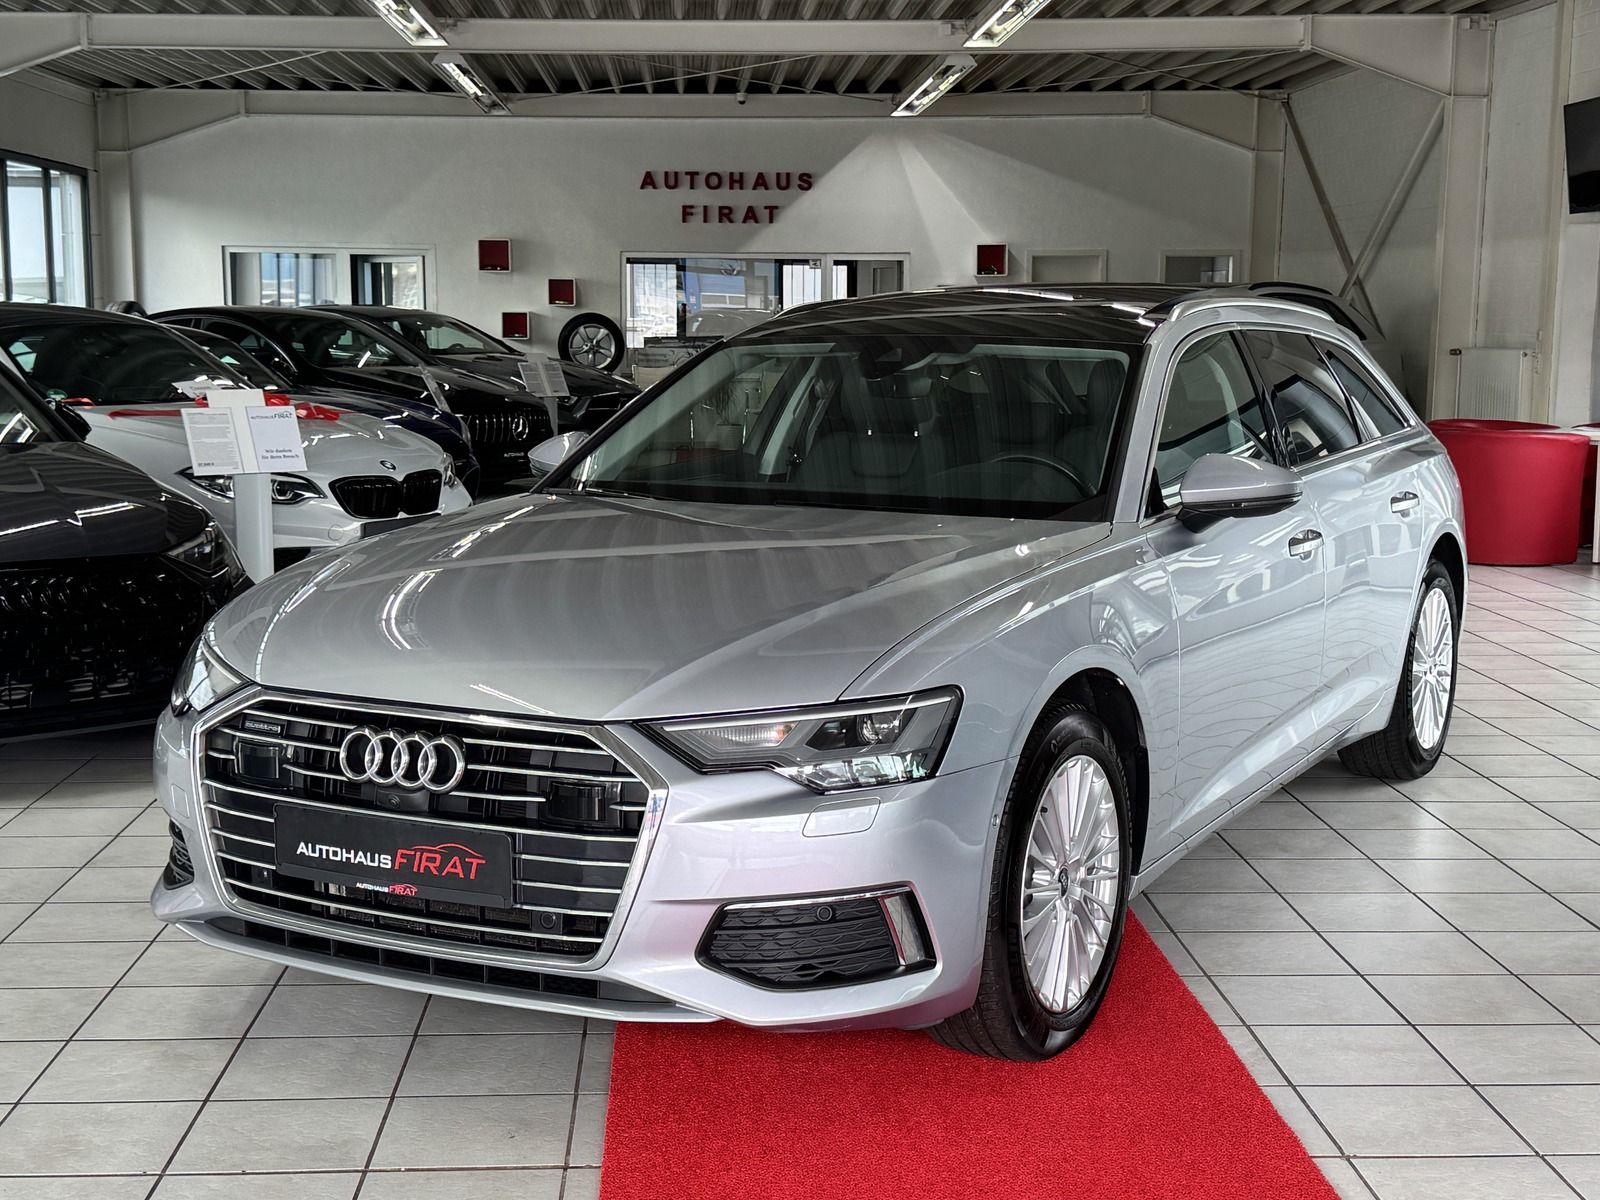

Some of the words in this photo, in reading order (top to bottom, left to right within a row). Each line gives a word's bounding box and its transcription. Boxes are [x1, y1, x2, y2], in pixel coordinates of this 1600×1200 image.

[640, 171, 813, 191] AUTOHAUS
[681, 205, 779, 224] FIRAT
[296, 841, 392, 869] AUTOHAUS
[394, 848, 487, 880] FIRAT
[356, 881, 389, 893] AUTOHAUS
[389, 884, 418, 897] FIRAT
